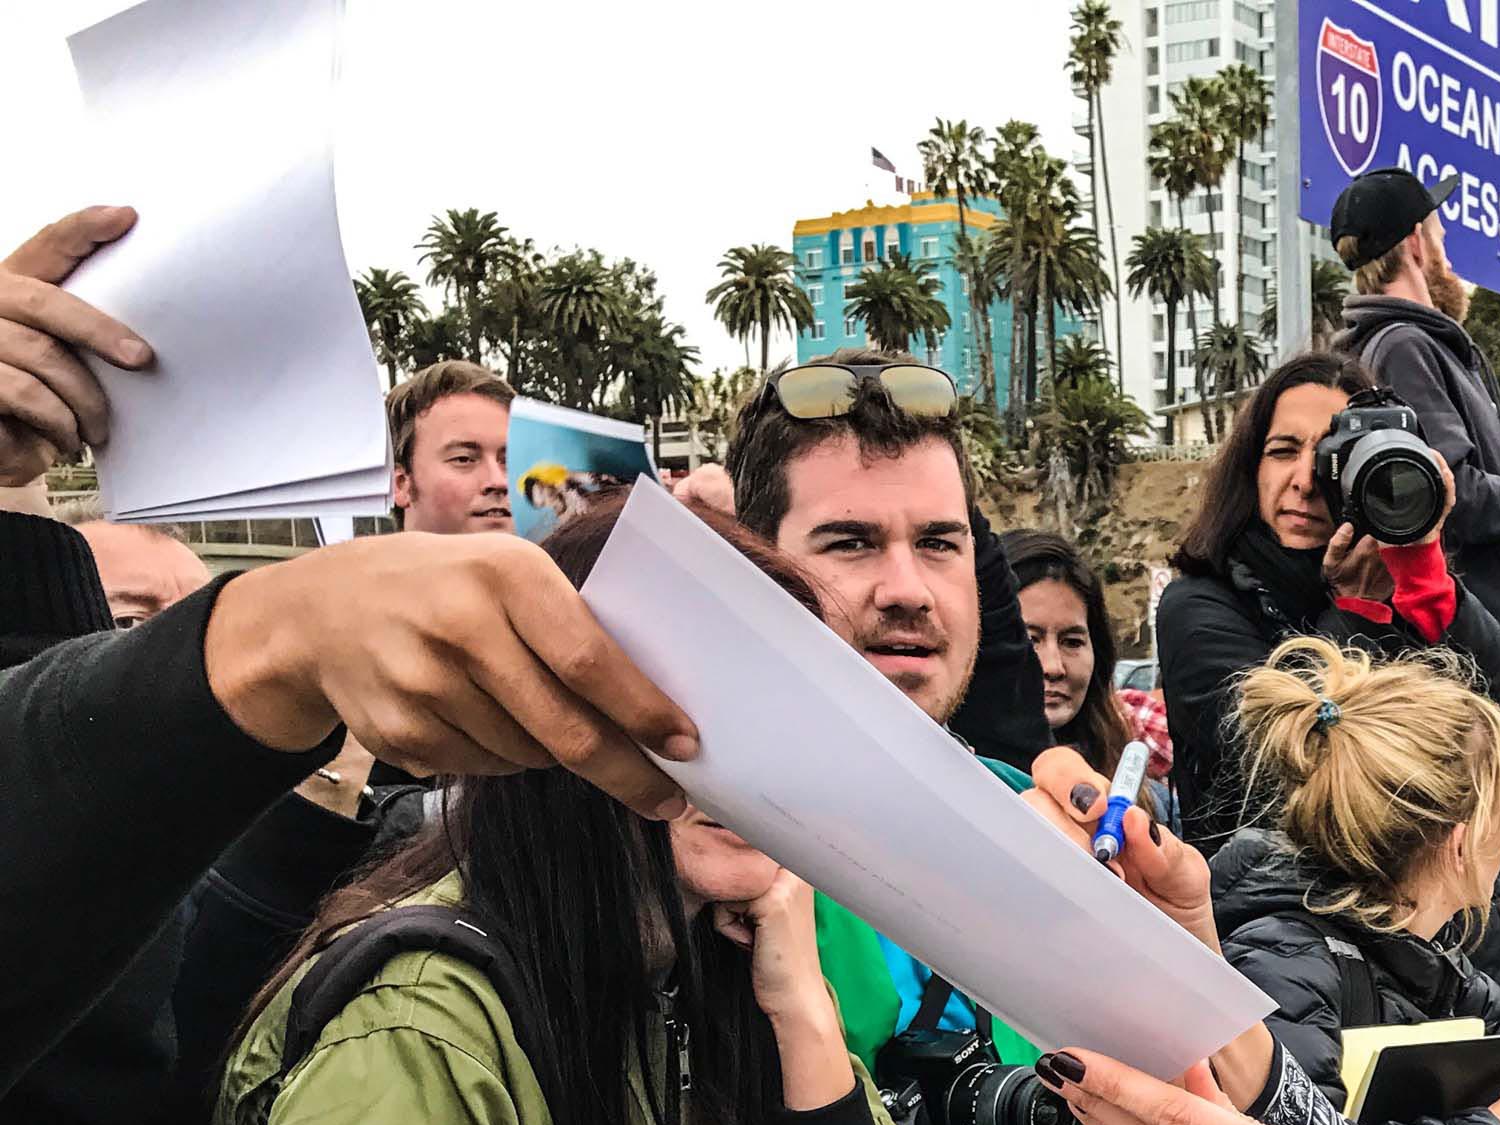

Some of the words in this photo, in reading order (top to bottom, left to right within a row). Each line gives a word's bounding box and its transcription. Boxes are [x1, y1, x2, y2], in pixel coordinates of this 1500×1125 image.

[1326, 29, 1372, 69] INTERSTATE
[1331, 73, 1369, 144] 10
[954, 1039, 981, 1064] SONY
